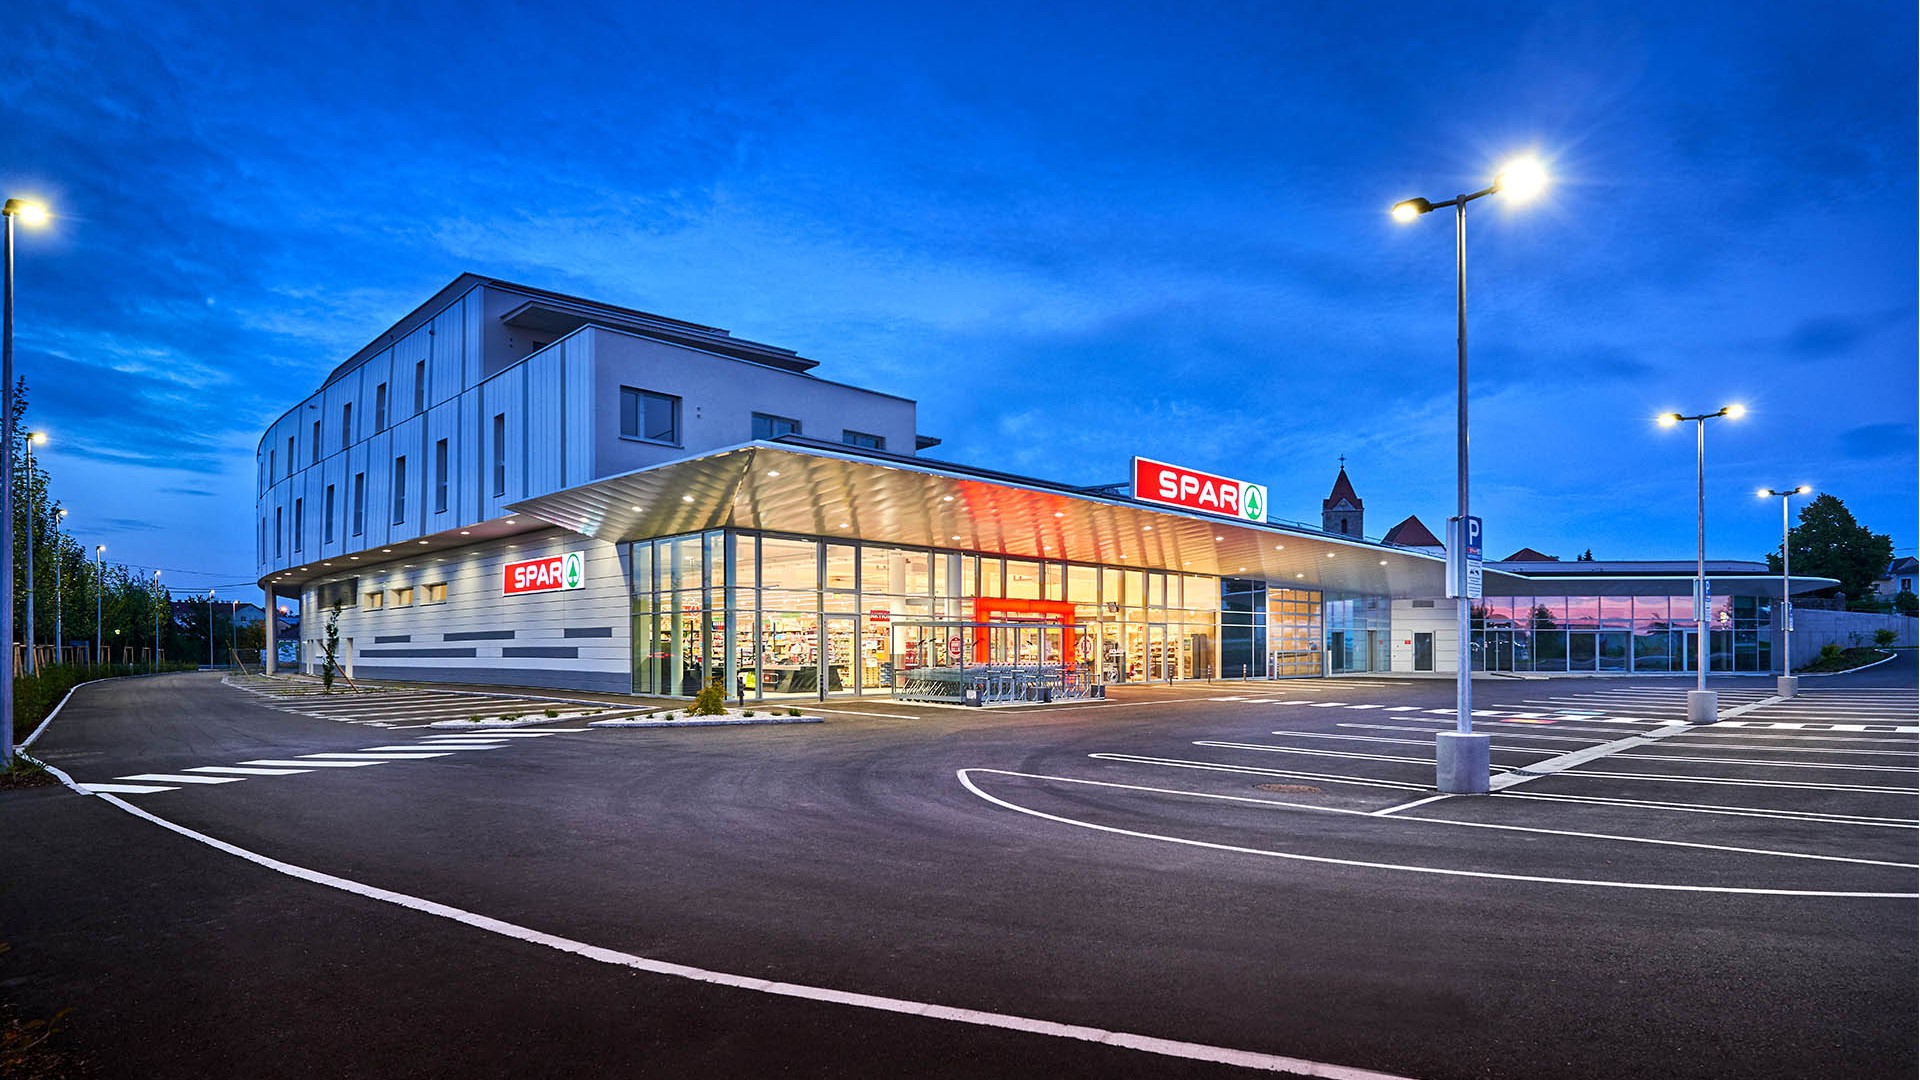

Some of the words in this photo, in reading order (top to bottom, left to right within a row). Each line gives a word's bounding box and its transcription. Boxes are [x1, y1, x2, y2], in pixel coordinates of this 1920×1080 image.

[1159, 470, 1238, 511] SPAR
[1469, 519, 1480, 545] P
[514, 561, 563, 589] SPAR
